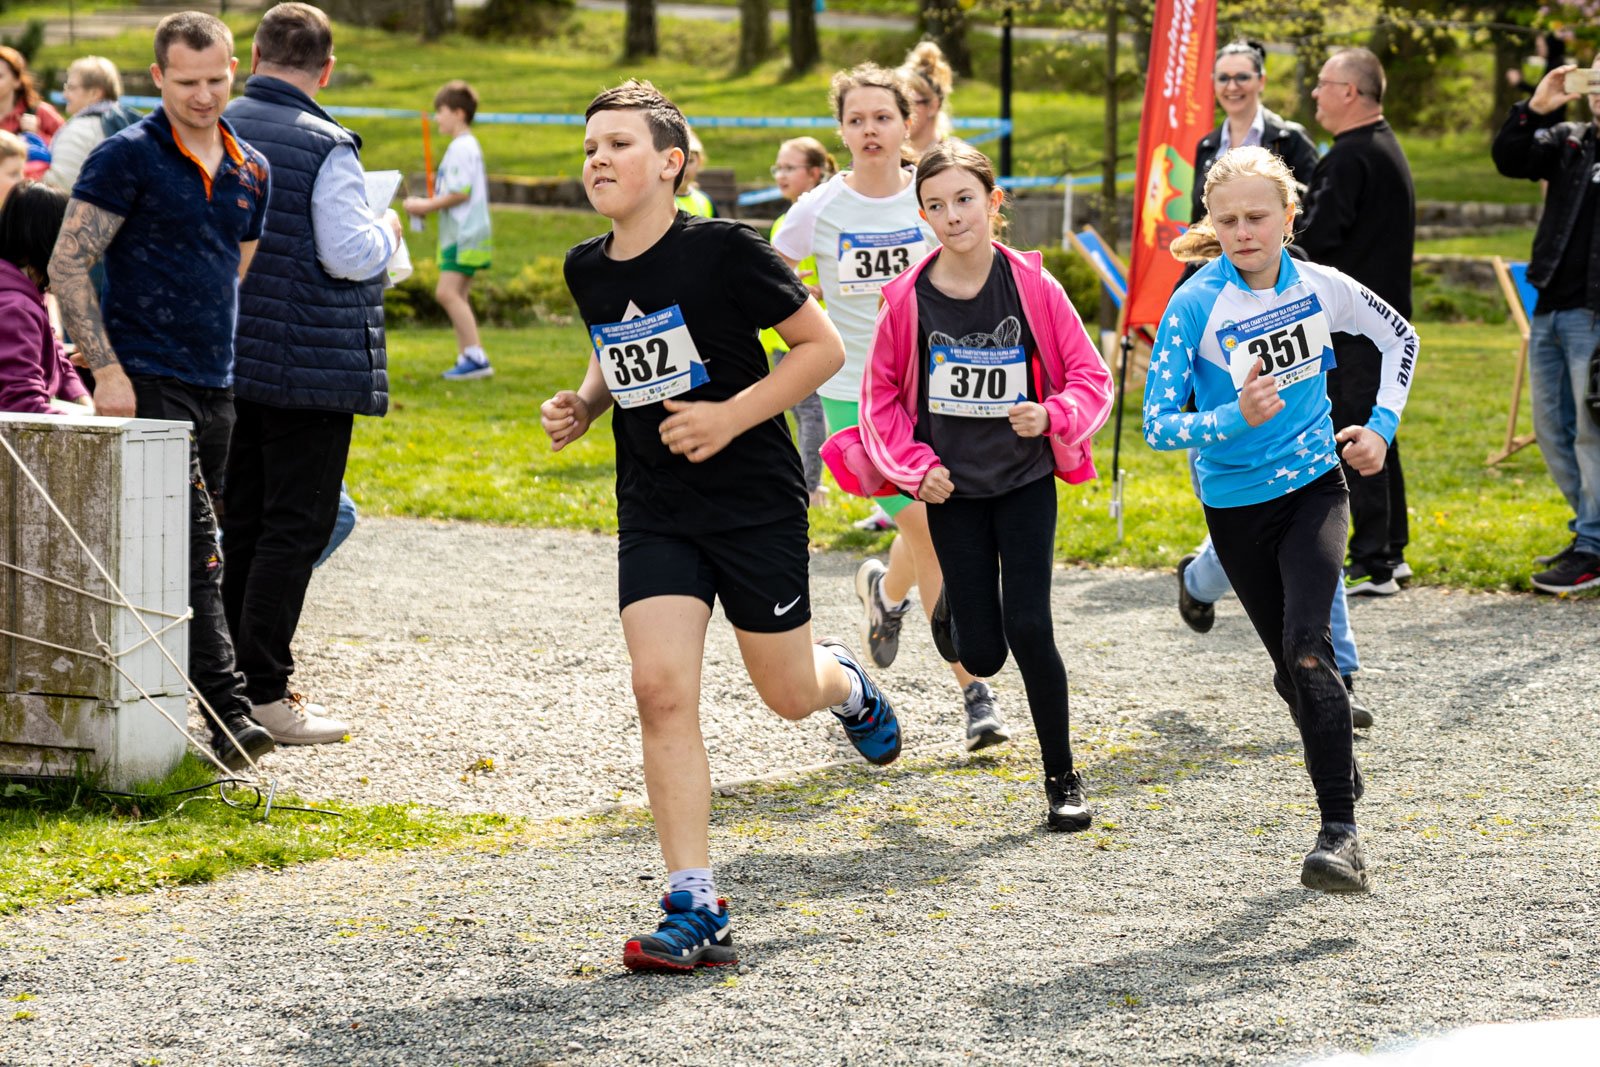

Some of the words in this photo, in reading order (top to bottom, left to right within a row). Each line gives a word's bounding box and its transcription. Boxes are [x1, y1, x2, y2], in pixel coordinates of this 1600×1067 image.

[855, 247, 910, 278] 343
[609, 338, 677, 386] 332
[1248, 324, 1311, 377] 351
[950, 365, 1007, 400] 370
